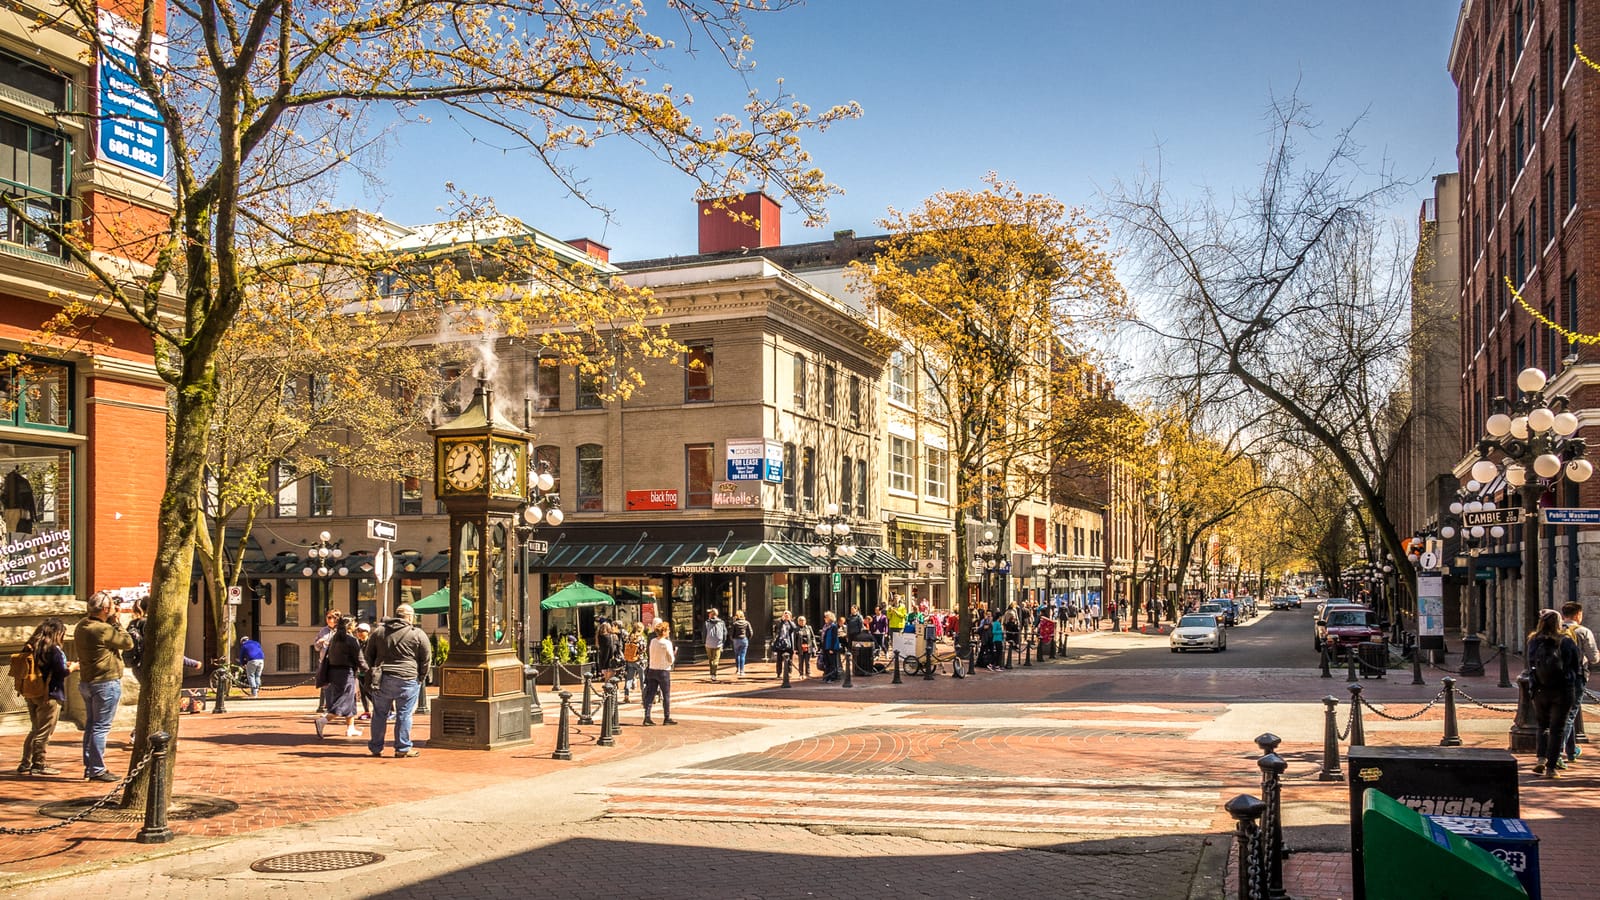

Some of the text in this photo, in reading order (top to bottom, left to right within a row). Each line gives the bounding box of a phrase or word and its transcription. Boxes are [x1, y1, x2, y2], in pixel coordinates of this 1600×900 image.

[743, 458, 759, 466] LEASE
[650, 490, 677, 505] black frog
[713, 491, 760, 505] Michelle's
[1468, 511, 1502, 525] CAMBIE
[1549, 511, 1567, 519] Public
[0, 529, 70, 555] tobombing
[39, 541, 70, 560] clock
[5, 570, 37, 586] since
[40, 557, 70, 576] 2018
[672, 565, 746, 573] STARBUCKS COFFEE
